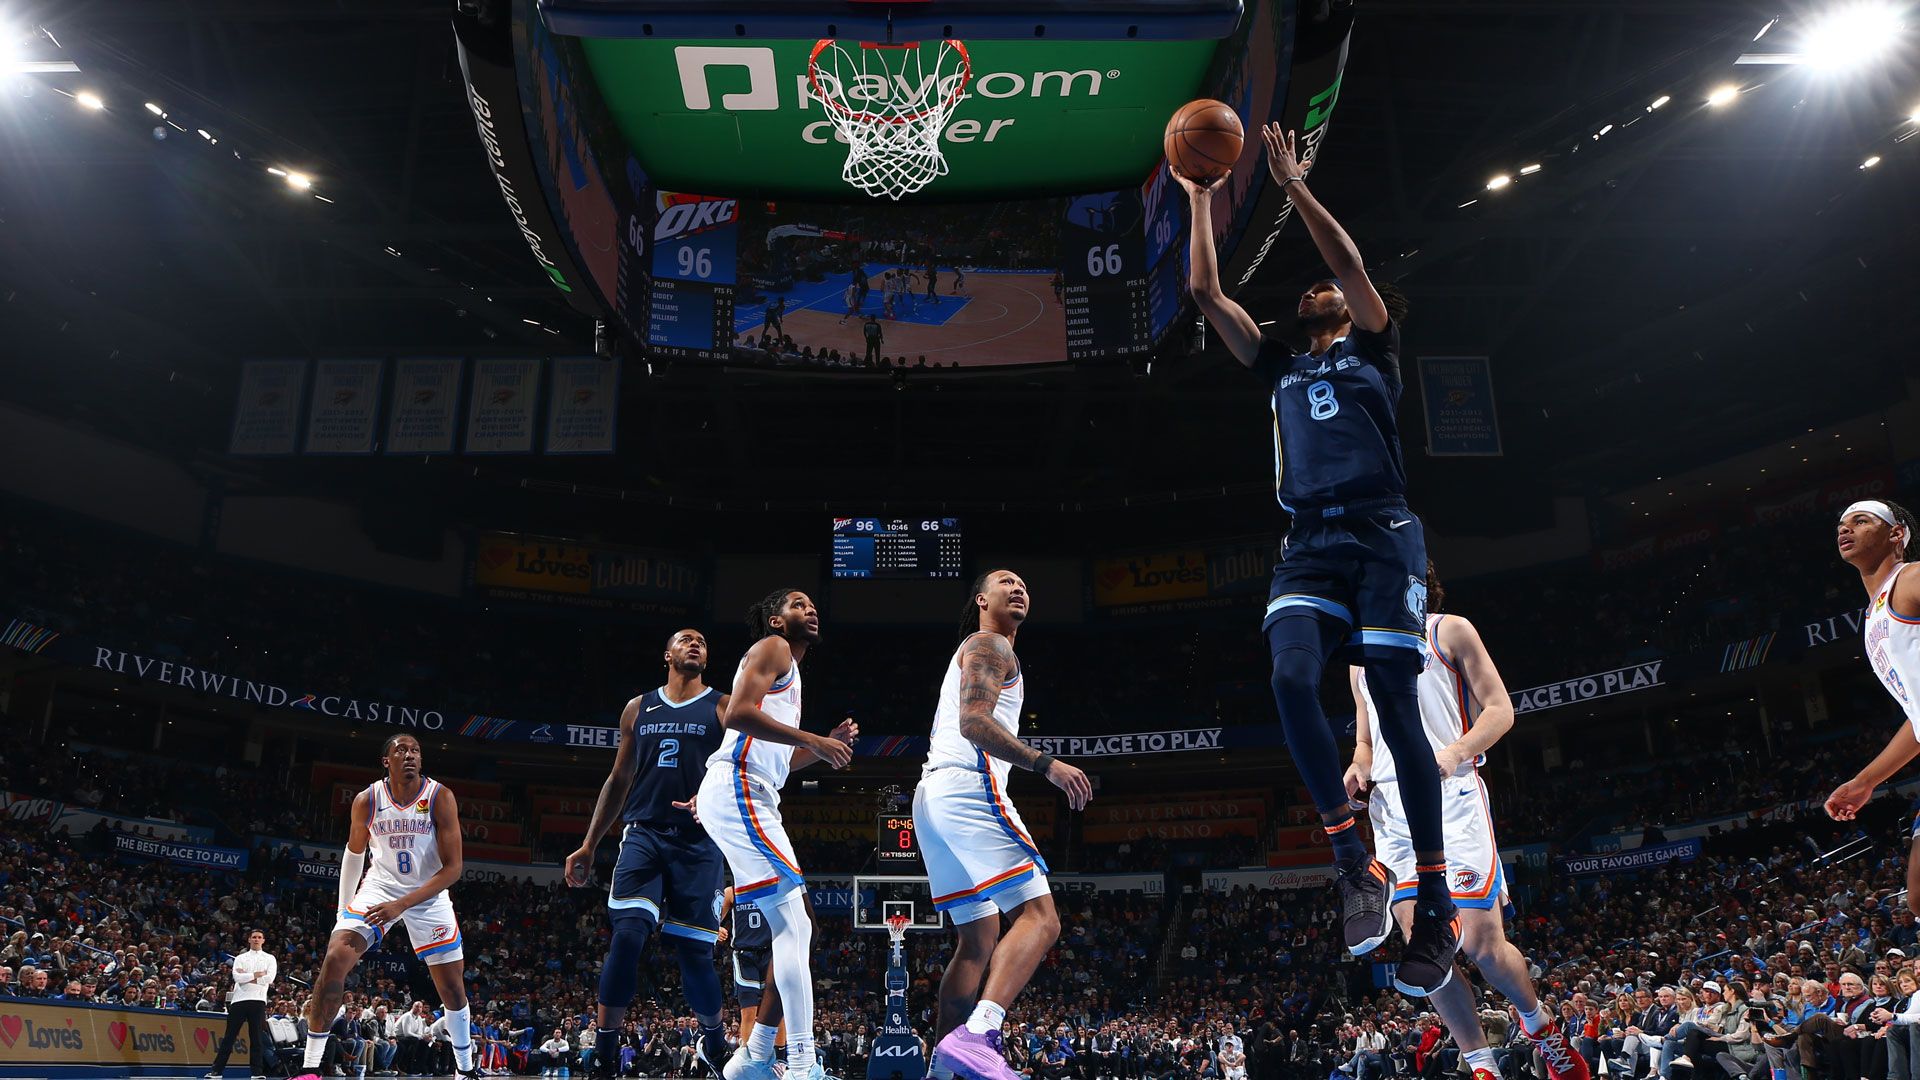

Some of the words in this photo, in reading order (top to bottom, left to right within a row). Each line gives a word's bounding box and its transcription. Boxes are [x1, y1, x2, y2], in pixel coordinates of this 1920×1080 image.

[469, 82, 505, 168] center
[495, 172, 554, 268] paycom
[655, 199, 737, 243] OKC
[677, 245, 712, 278] 96
[1087, 244, 1122, 277] 66
[654, 280, 675, 289] PLAYER
[1066, 285, 1087, 293] PLAYER
[652, 303, 679, 312] WILLIAMS
[651, 313, 678, 322] WILLIAMS
[1067, 328, 1094, 336] WILLIAMS
[1307, 379, 1340, 421] 8
[856, 521, 874, 531] 96
[921, 521, 939, 531] 66
[93, 646, 287, 708] RIVERWIND
[321, 695, 444, 731] CASINO
[1566, 678, 1598, 702] TO
[1604, 663, 1662, 694] PLAY
[566, 726, 608, 745] THE
[639, 722, 707, 736] GRIZZLIES
[1070, 736, 1133, 755] PLACE
[1137, 734, 1166, 751] TO
[1171, 730, 1222, 750] PLAY
[657, 738, 680, 768] 2
[1108, 803, 1239, 823] RIVERWIND
[372, 818, 433, 837] OKLAHOMA
[887, 818, 914, 830] 10:46
[1127, 824, 1213, 840] CASINO
[389, 834, 416, 849] CITY
[899, 829, 911, 849] 8
[115, 836, 135, 849] THE
[136, 840, 159, 854] BEST
[160, 844, 193, 860] PLACE
[195, 849, 210, 861] TO
[213, 852, 240, 865] PLAY
[1566, 858, 1599, 873] YOUR
[1601, 852, 1654, 870] FAVORITE
[1655, 844, 1693, 861] GAMES!
[297, 863, 326, 876] YOUR
[397, 850, 412, 875] 8
[1268, 872, 1301, 889] Bally
[1301, 873, 1327, 883] SPORTS
[813, 891, 865, 906] SINO
[748, 911, 761, 929] 0
[885, 1025, 910, 1034] Health
